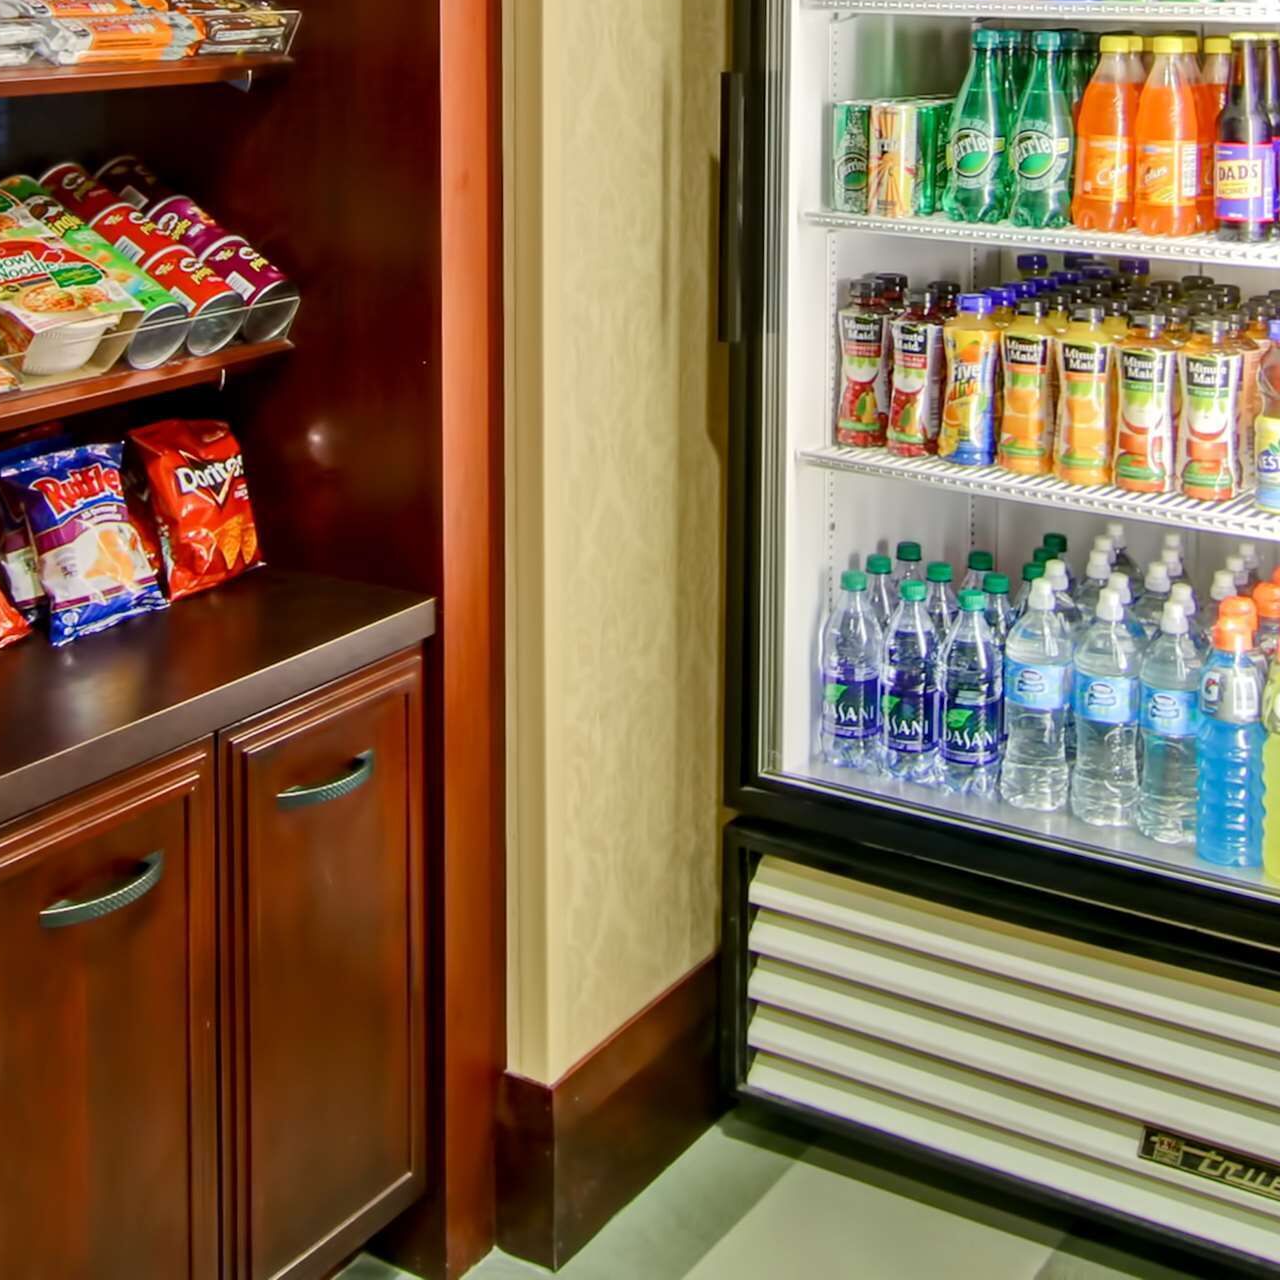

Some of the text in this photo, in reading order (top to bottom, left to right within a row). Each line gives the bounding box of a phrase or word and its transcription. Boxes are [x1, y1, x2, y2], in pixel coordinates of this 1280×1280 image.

[954, 133, 988, 159] errie
[1015, 136, 1052, 160] errie
[1006, 337, 1043, 352] Minute
[1012, 349, 1040, 361] Maid
[1188, 361, 1227, 376] Minute
[30, 462, 124, 517] Ruffle
